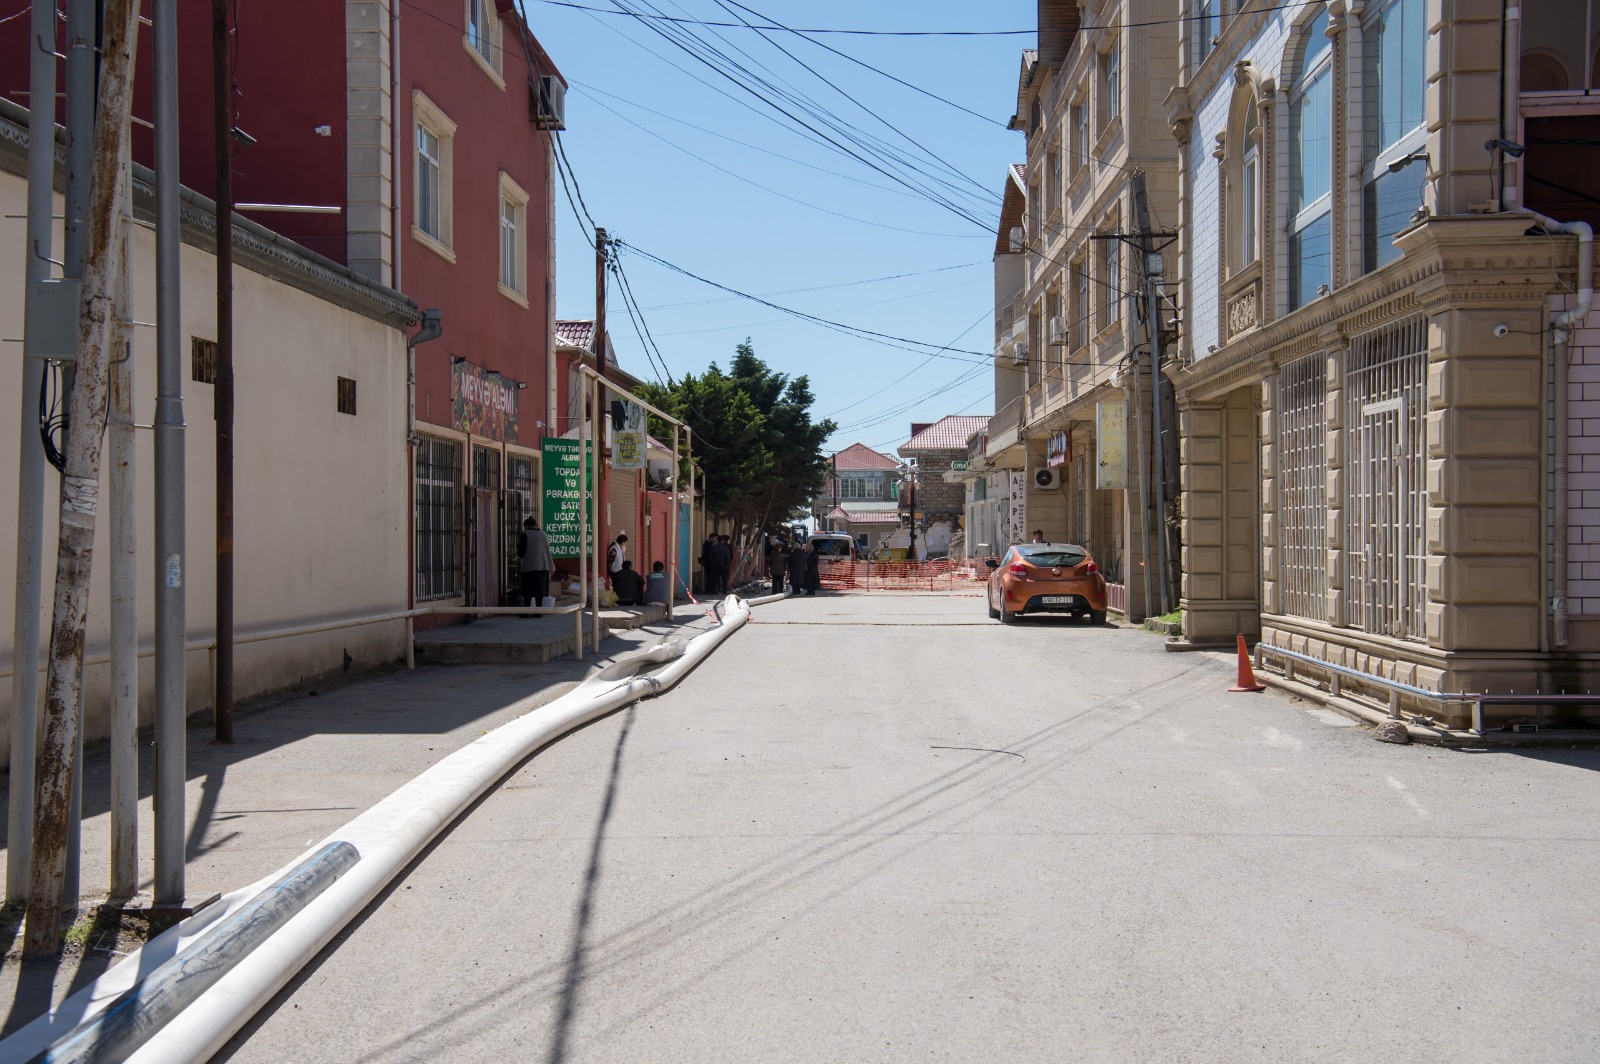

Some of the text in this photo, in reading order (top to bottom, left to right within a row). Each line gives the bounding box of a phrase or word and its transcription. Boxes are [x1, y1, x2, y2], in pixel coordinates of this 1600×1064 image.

[461, 371, 491, 406] MEYVƏ
[544, 444, 567, 453] MEYVƏ
[554, 467, 581, 477] TOPDA
[565, 478, 577, 488] VƏ
[554, 512, 576, 521] UCUZ
